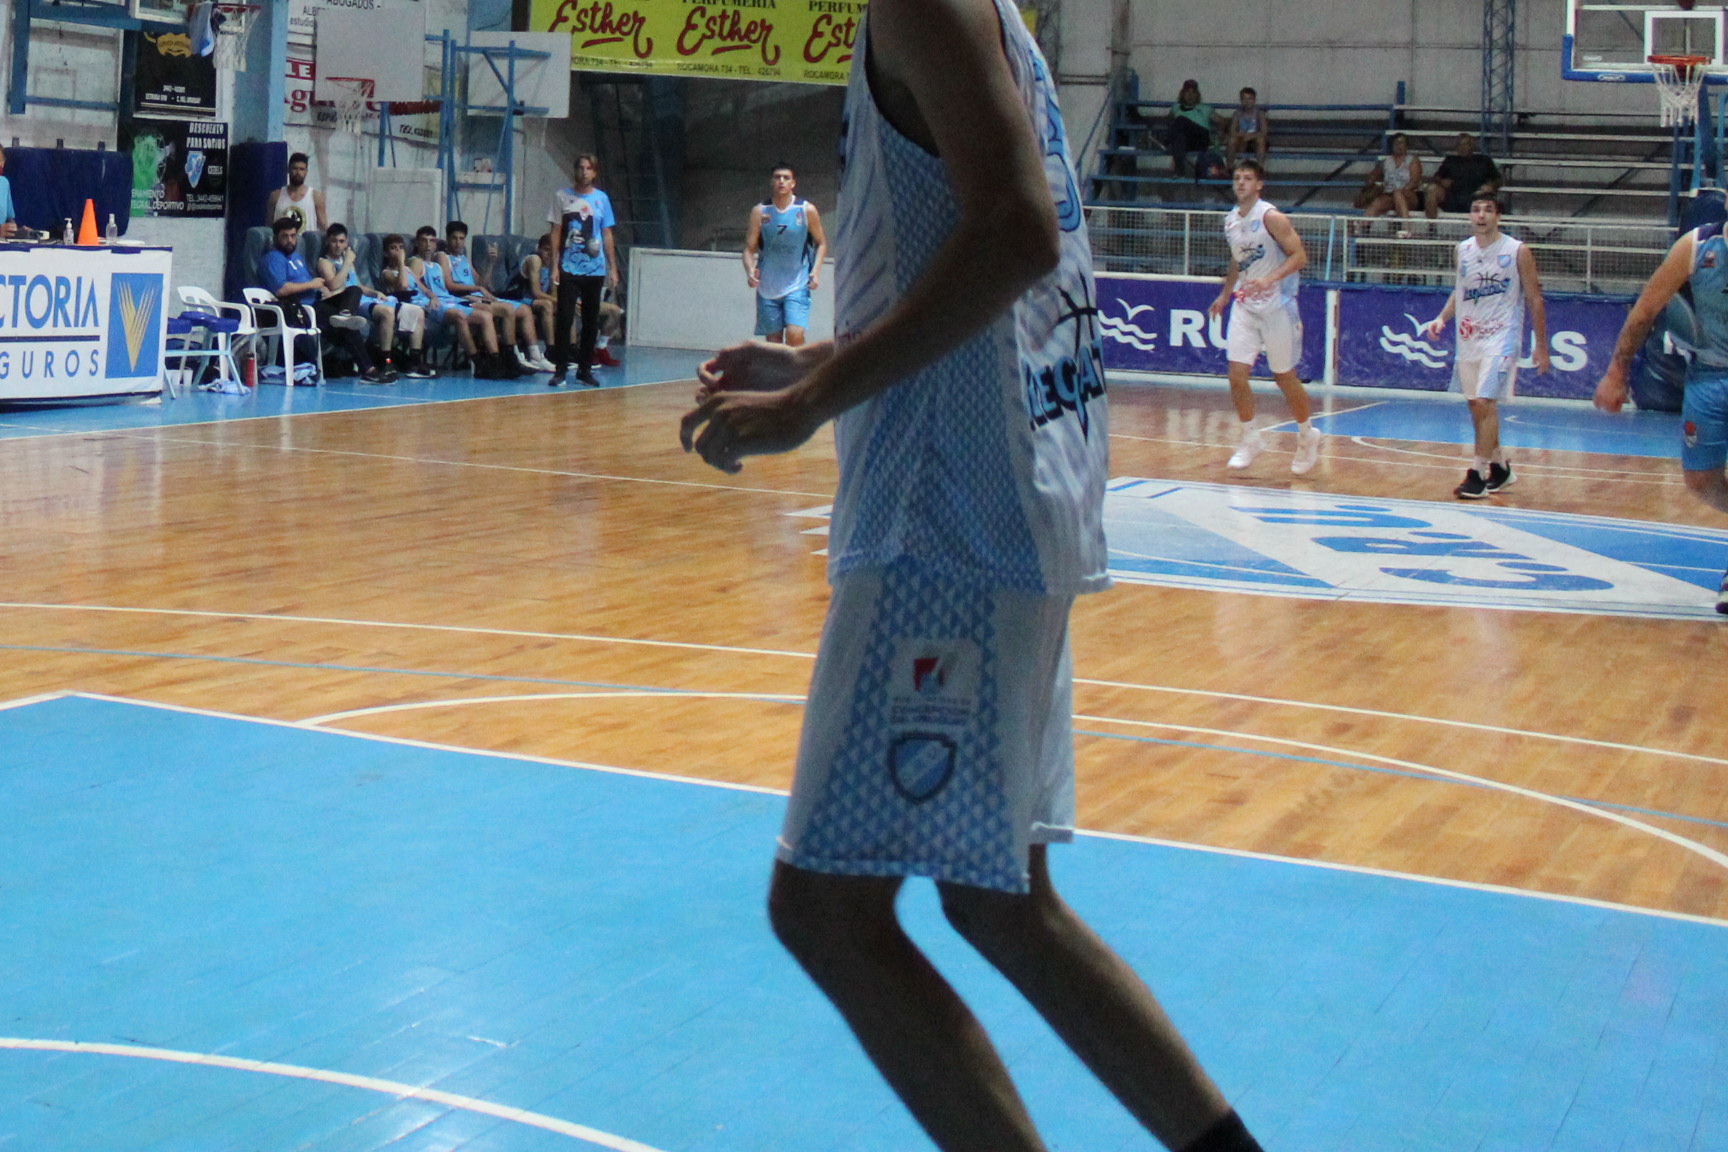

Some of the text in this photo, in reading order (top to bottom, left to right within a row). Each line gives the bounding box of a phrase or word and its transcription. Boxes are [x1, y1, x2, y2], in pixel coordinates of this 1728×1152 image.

[676, 5, 781, 66] Esther
[804, 13, 856, 64] Est
[677, 62, 719, 73] ROCAMORA
[804, 69, 845, 80] ROCAMORA
[189, 122, 224, 135] DESCUENTO
[186, 136, 226, 149] PARA SOCIOS
[131, 188, 165, 199] ENAMIENTO
[153, 200, 185, 211] DEPORTIVO
[777, 224, 787, 235] 7
[1169, 309, 1228, 350] RU
